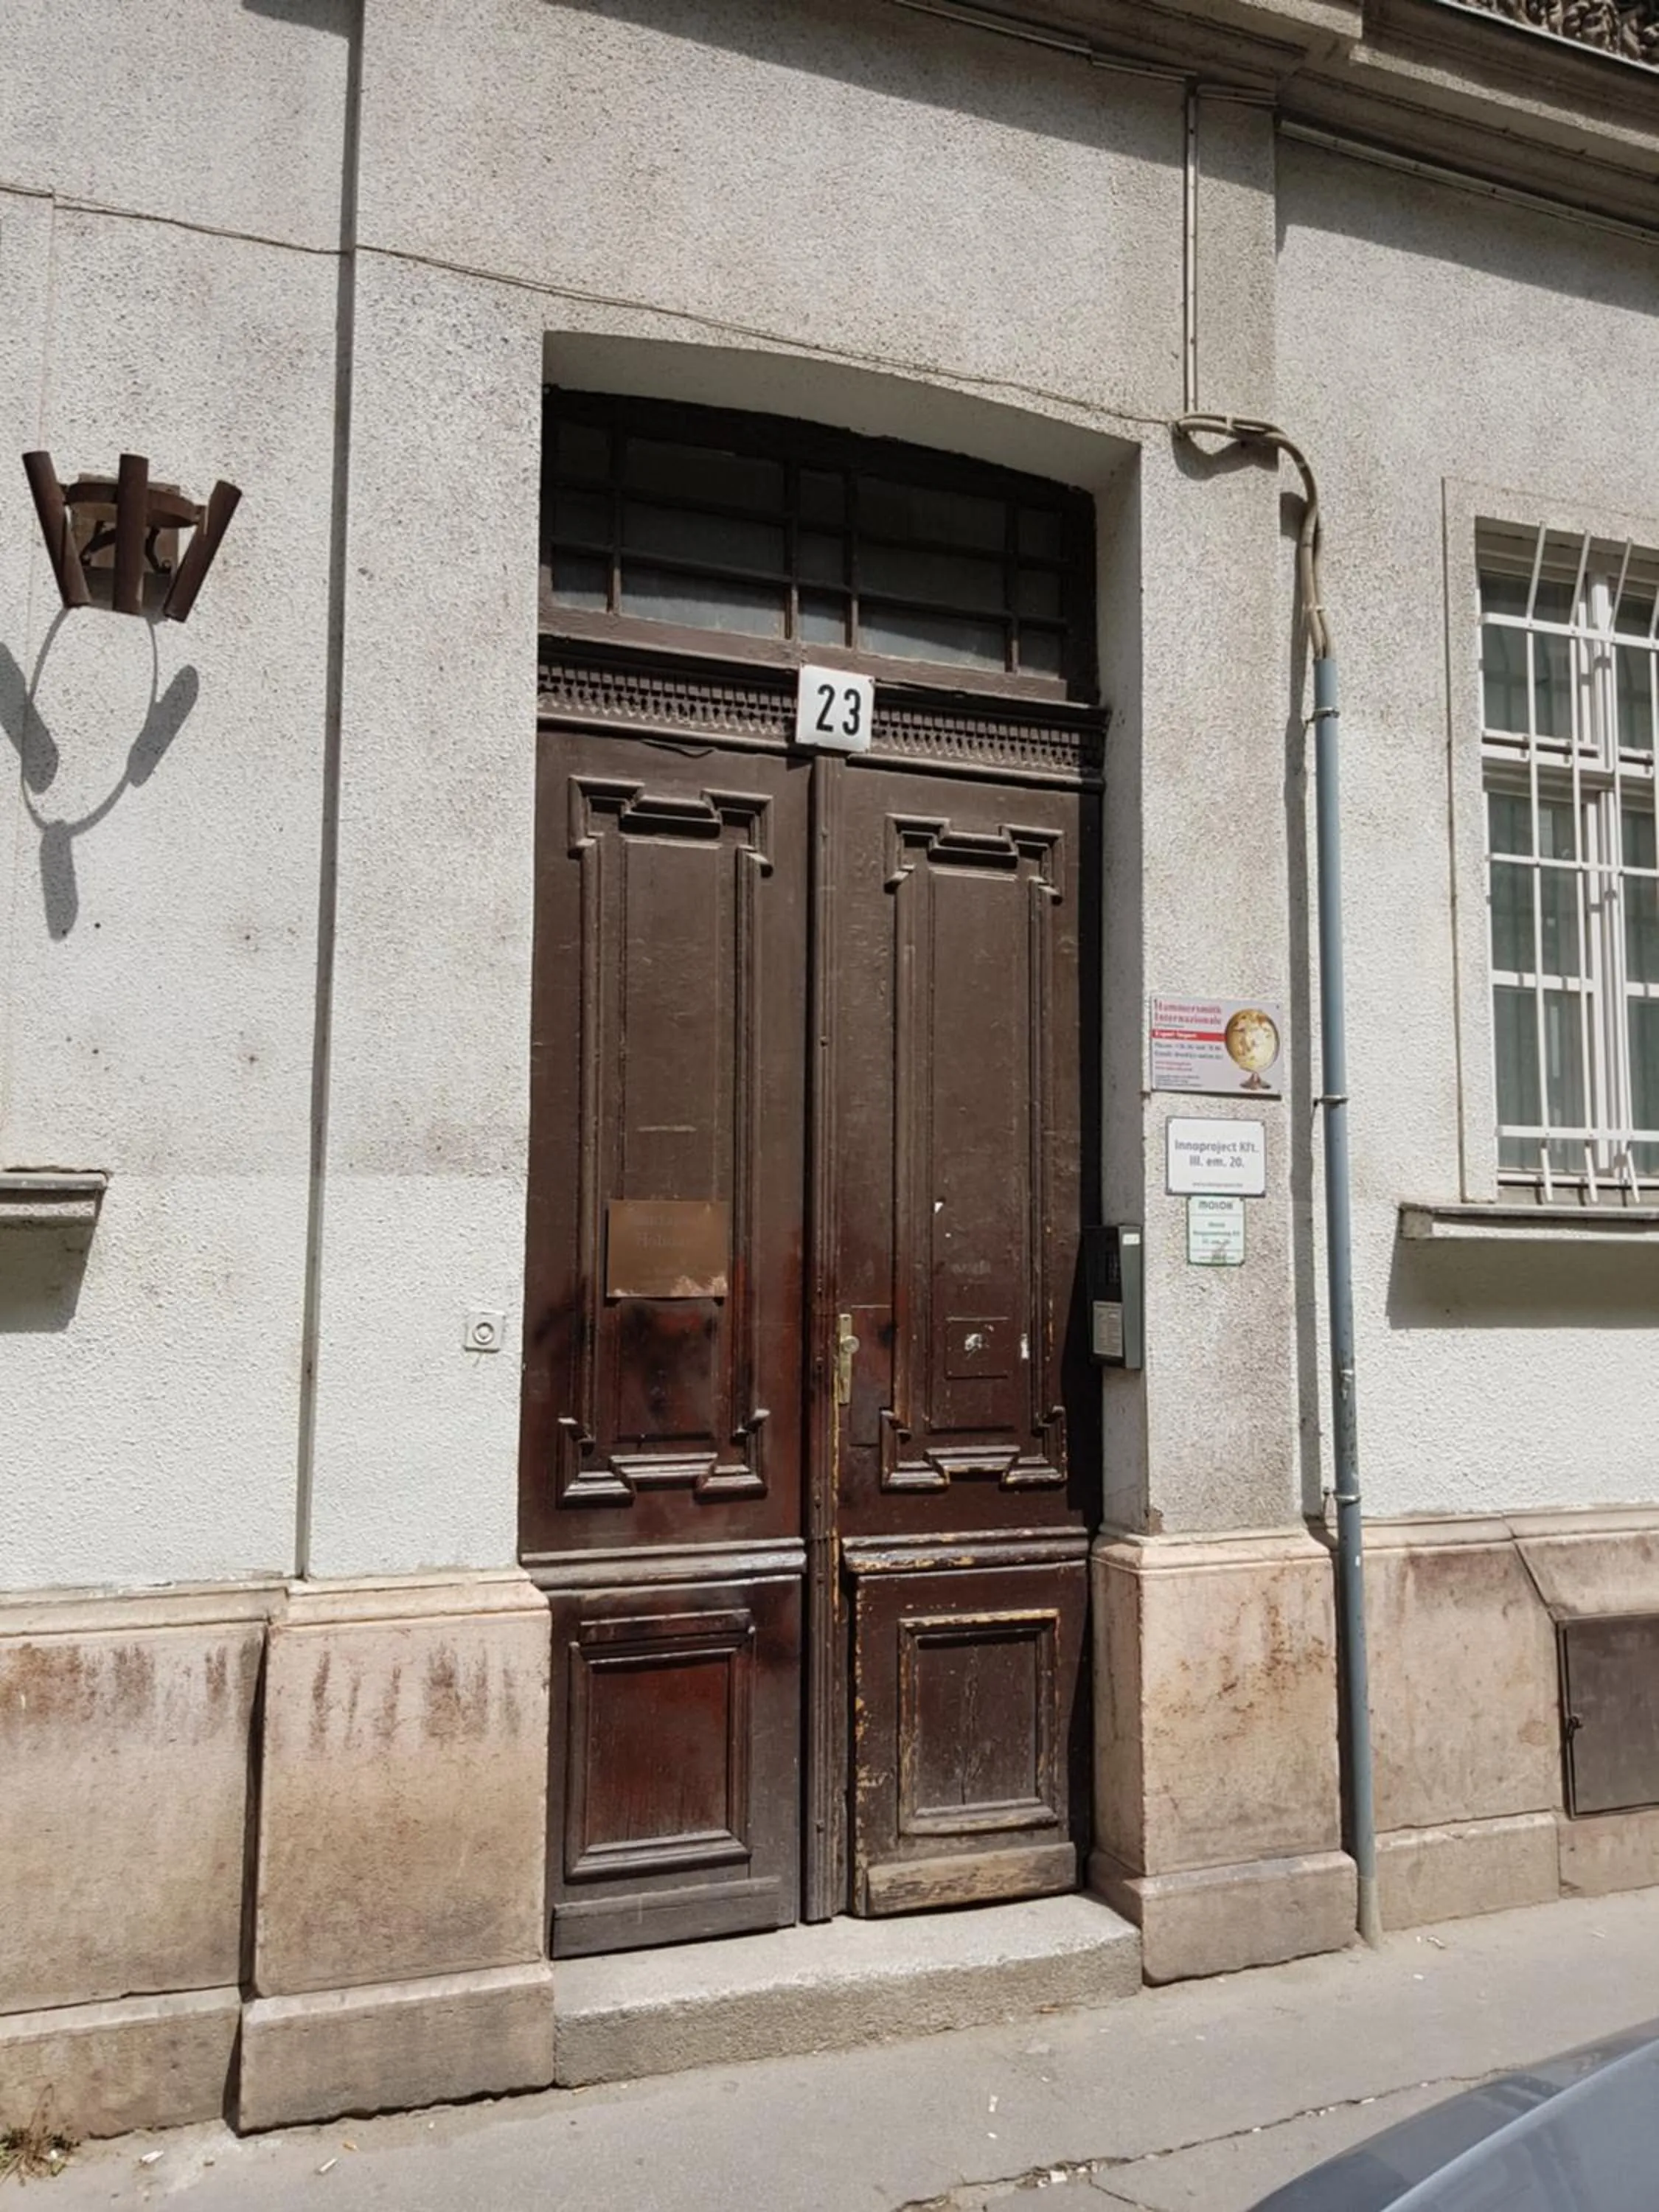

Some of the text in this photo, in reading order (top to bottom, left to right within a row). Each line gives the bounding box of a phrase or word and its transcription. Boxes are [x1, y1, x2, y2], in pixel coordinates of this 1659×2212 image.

[815, 684, 861, 736] 23
[1175, 1138, 1259, 1154] Innoproject Kft.
[1206, 1158, 1227, 1167] em.
[1229, 1155, 1245, 1168] 20.
